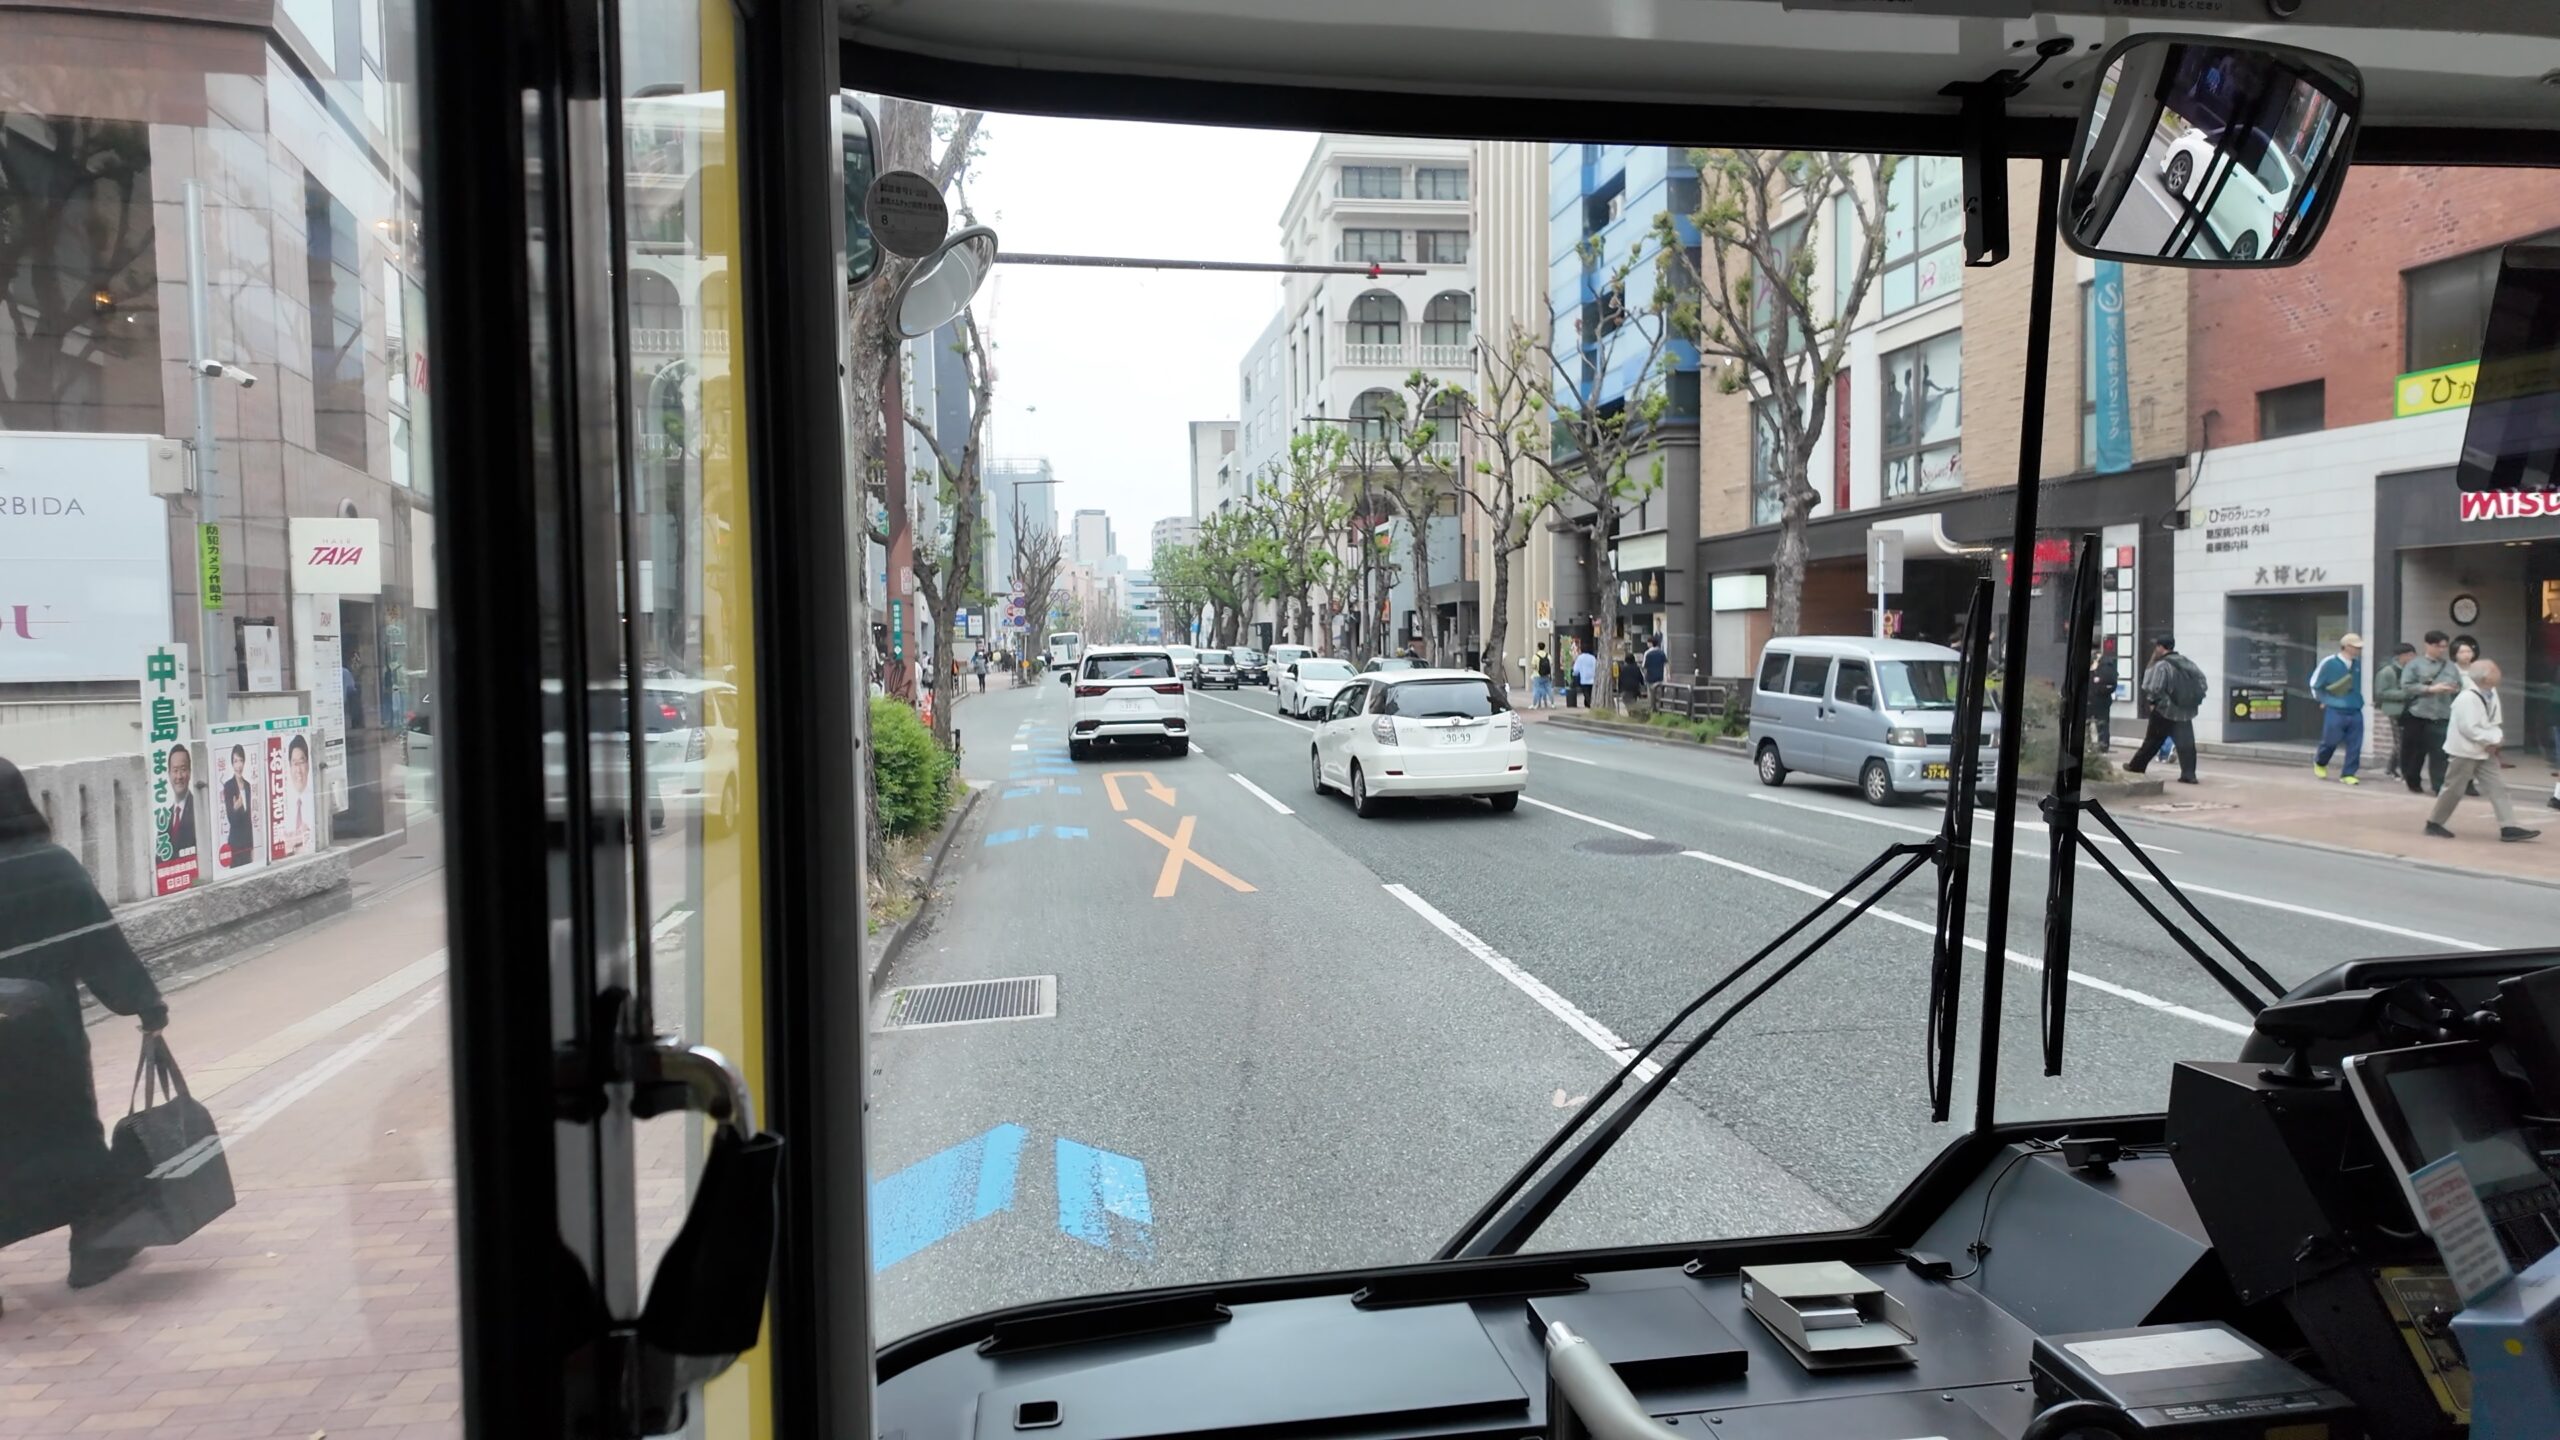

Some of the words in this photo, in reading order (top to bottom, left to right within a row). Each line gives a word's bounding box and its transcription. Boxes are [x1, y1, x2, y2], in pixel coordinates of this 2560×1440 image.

[2430, 374, 2477, 405] ひか
[205, 525, 223, 603] 防犯カメラ作動中
[308, 546, 363, 566] TAYA
